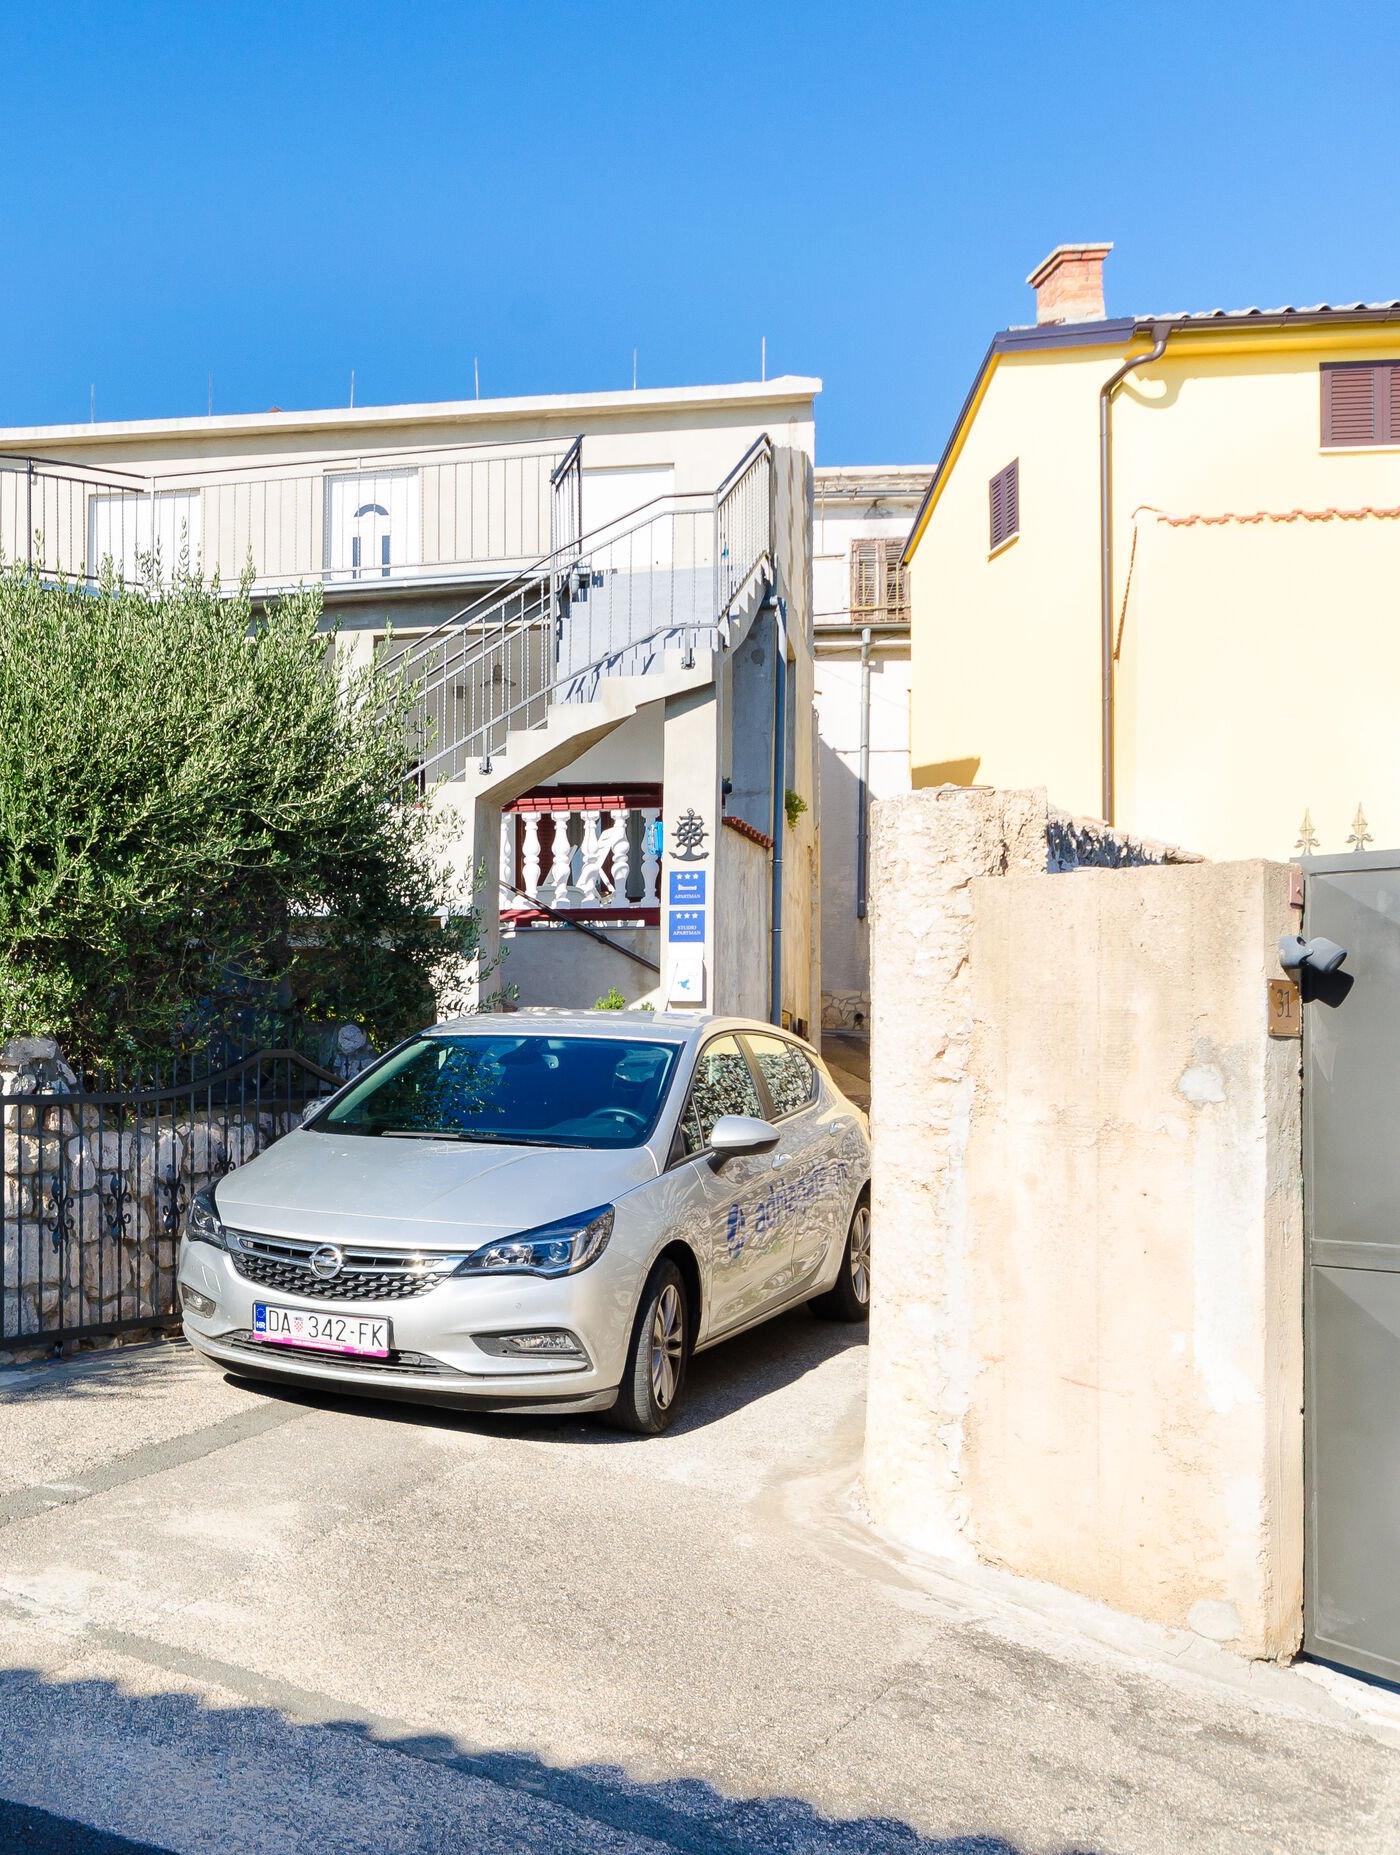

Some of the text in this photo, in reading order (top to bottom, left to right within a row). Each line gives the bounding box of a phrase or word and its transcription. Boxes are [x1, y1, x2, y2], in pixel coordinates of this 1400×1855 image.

[1276, 989, 1292, 1018] 31
[256, 1320, 266, 1330] HR
[269, 1310, 291, 1334] DA
[308, 1316, 384, 1348] 342-FK
